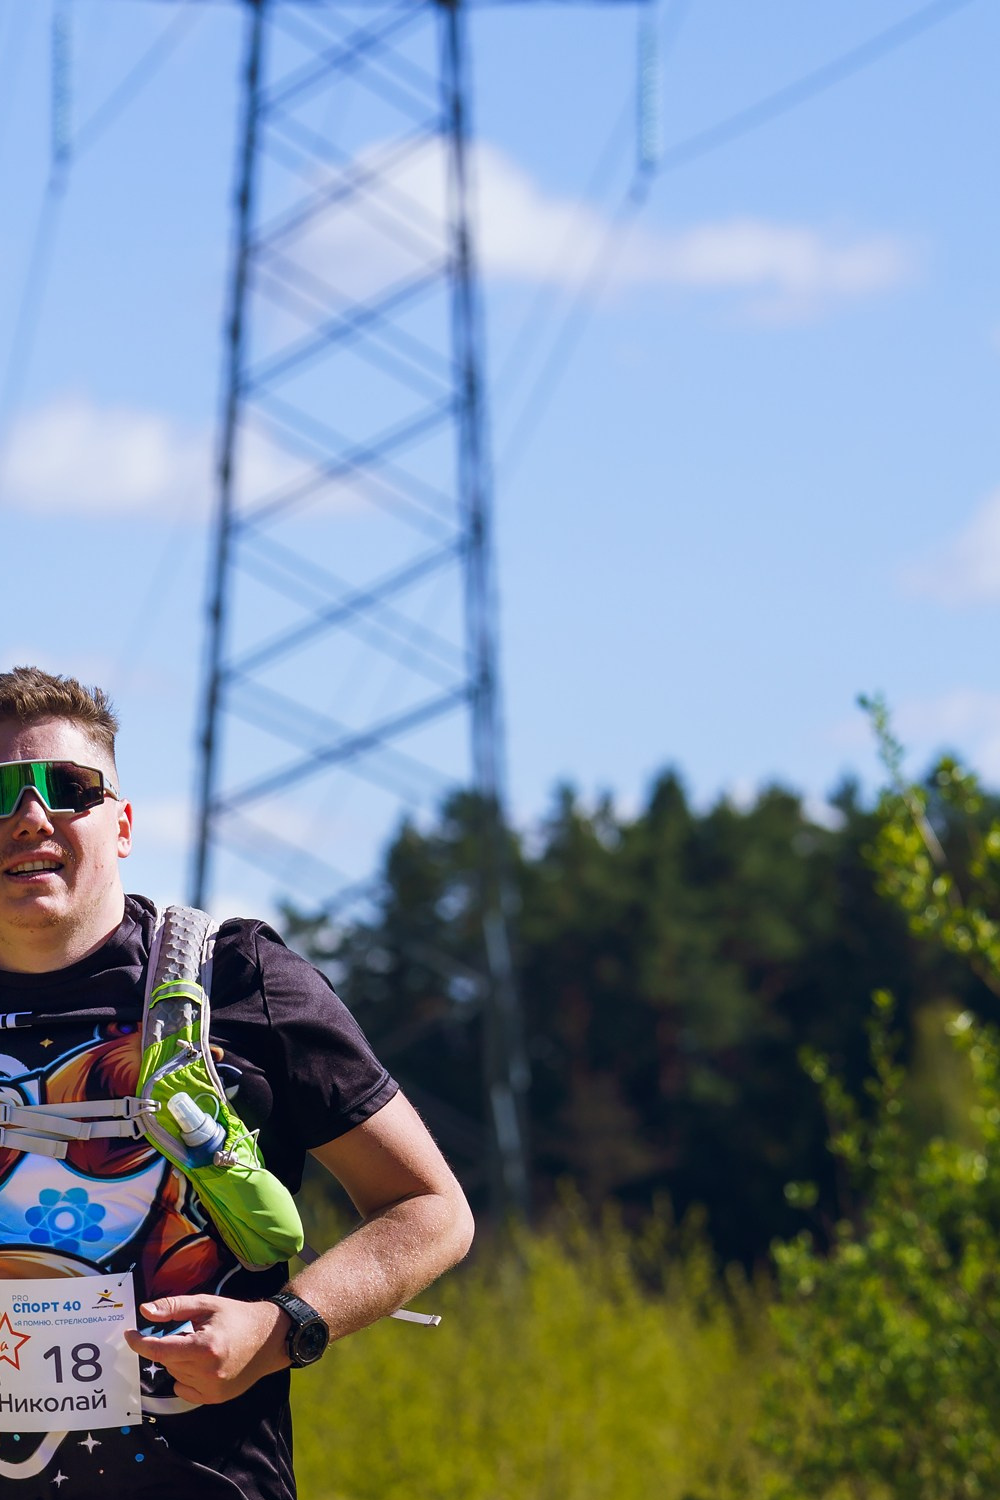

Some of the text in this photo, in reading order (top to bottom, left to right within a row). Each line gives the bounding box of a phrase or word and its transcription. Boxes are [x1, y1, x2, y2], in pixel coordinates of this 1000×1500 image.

[13, 1302, 60, 1314] СПОРТ
[63, 1301, 82, 1312] 40
[108, 1314, 125, 1322] 2025
[43, 1342, 103, 1384] 18
